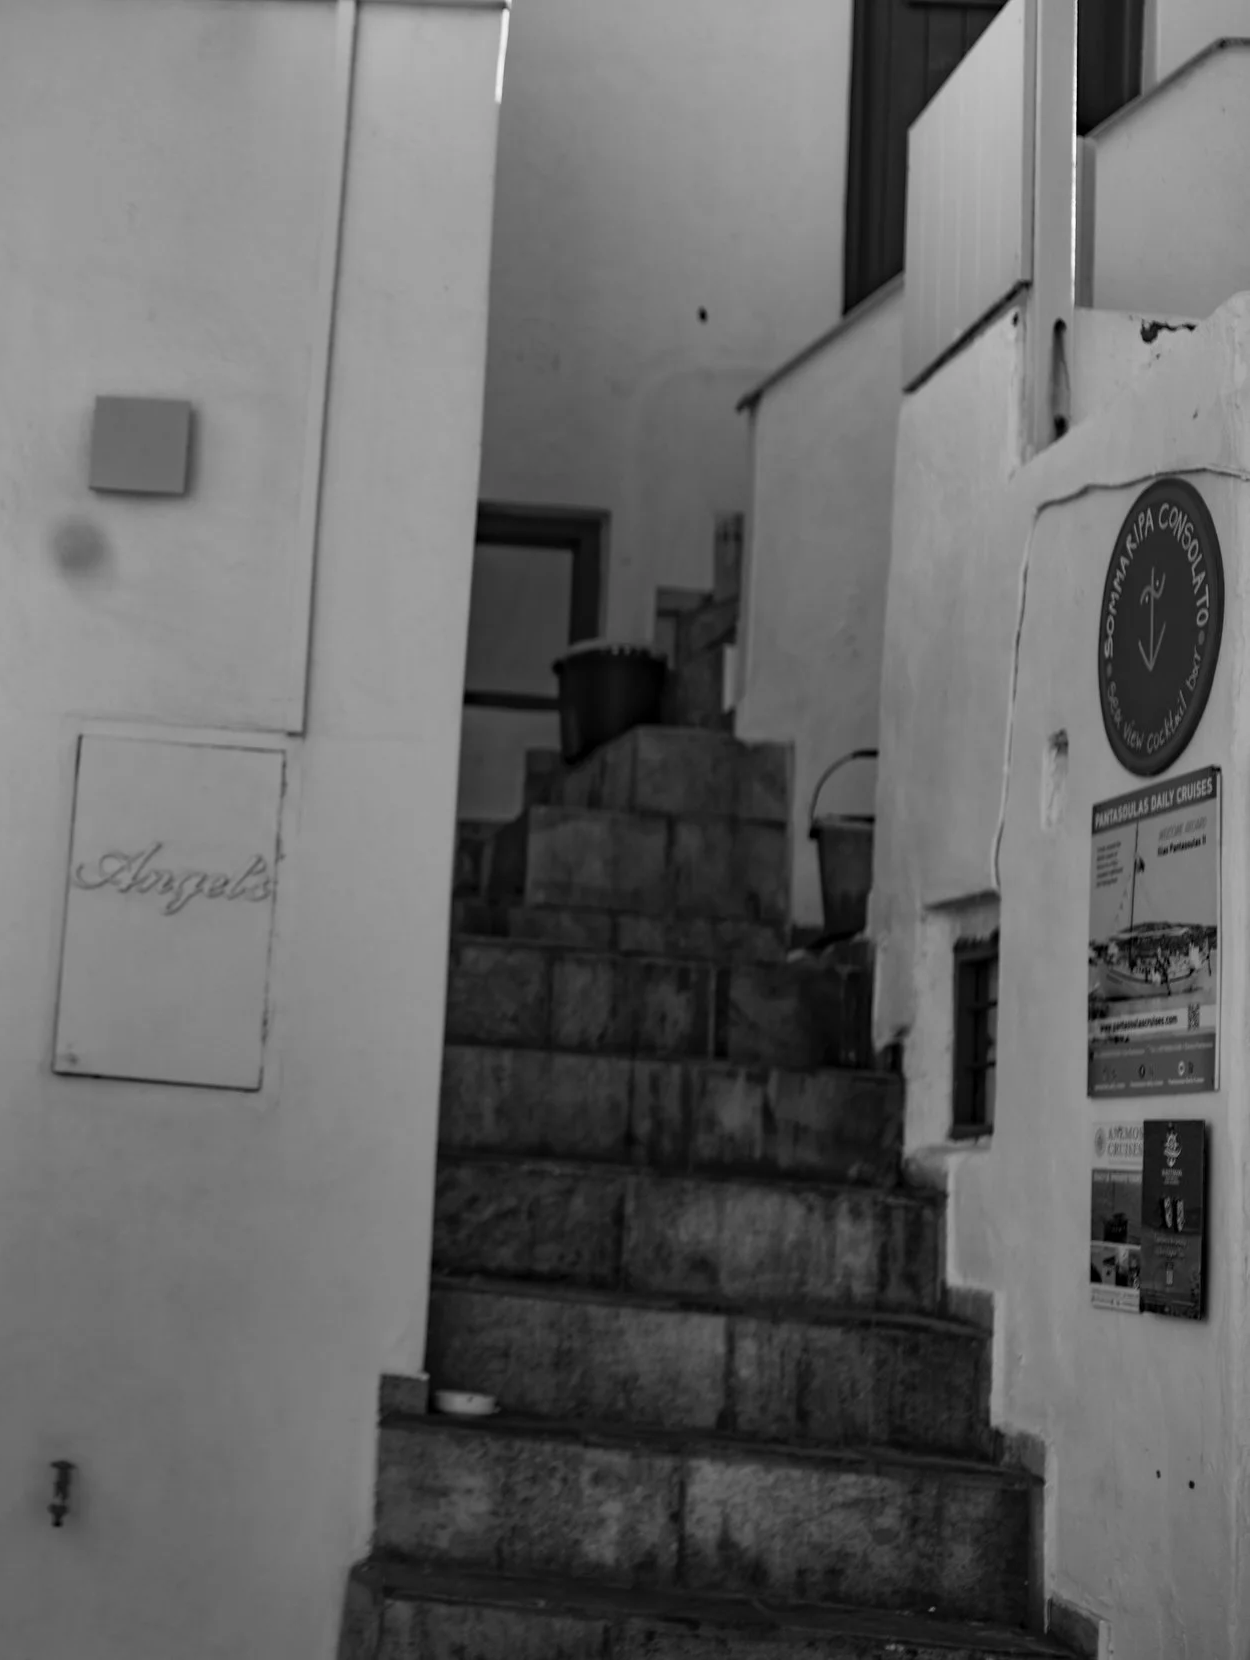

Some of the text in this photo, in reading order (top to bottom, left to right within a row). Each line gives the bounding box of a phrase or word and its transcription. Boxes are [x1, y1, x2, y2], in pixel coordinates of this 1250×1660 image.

[1104, 502, 1210, 660] SOMMARIPA CONSOLATO
[1123, 718, 1145, 753] view
[1146, 690, 1188, 755] cocktail
[1186, 645, 1202, 688] bar
[1094, 776, 1213, 830] PANTASOULAS DAILY CRUISES
